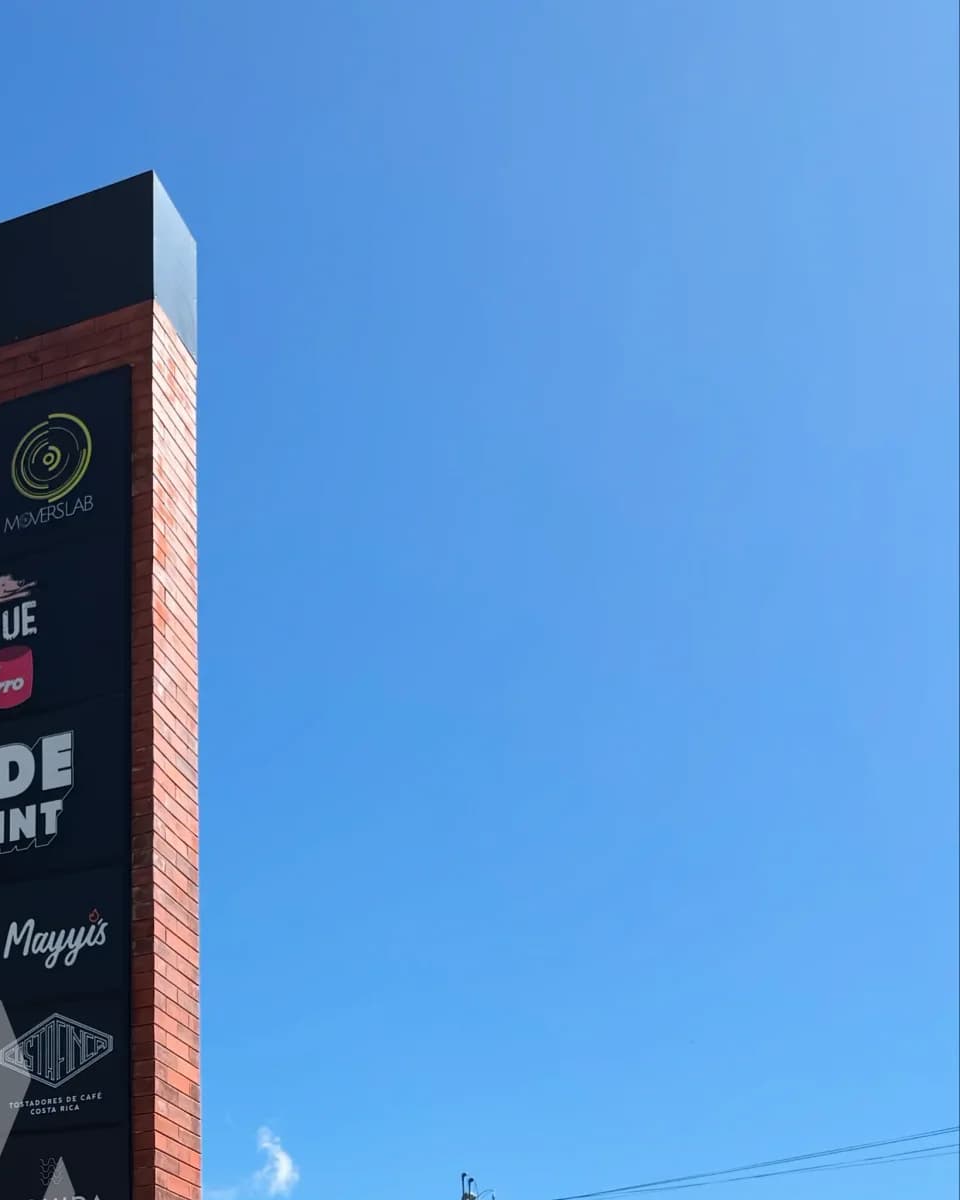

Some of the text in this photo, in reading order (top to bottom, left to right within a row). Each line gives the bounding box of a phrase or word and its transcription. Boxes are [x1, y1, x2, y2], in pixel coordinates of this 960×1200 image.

[3, 495, 94, 533] MOVERSLAB
[9, 1091, 103, 1110] TOSTADORES DE CAFÉ
[30, 1104, 80, 1115] COSTA RICA
